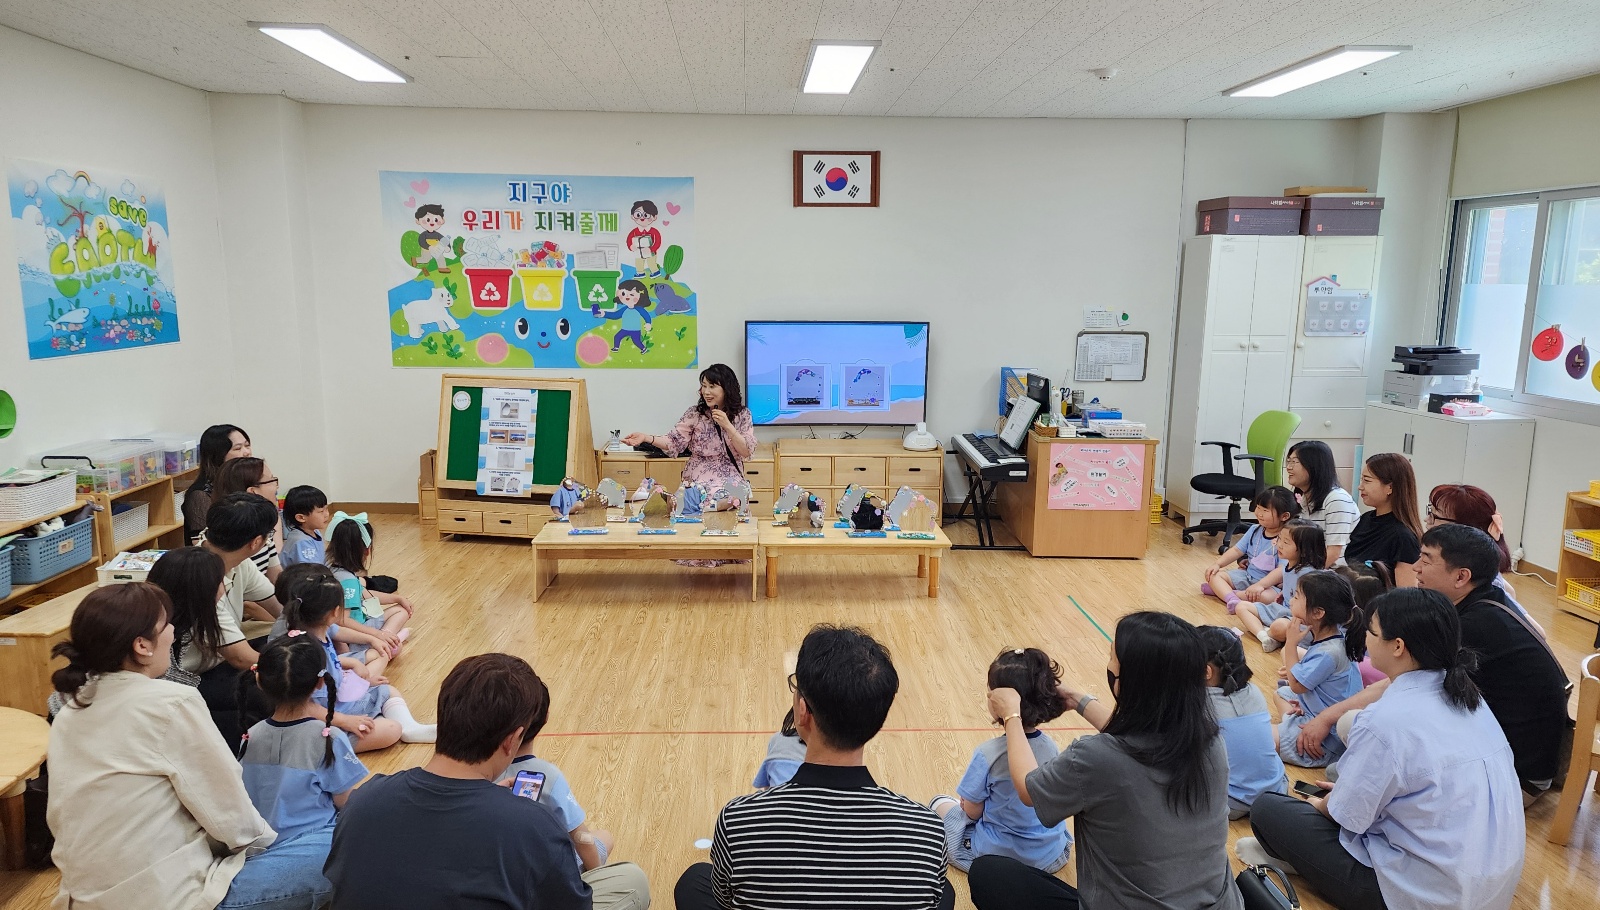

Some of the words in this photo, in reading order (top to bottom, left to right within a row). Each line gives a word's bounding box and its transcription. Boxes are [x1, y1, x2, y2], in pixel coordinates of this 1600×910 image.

[508, 181, 572, 205] 지구야
[108, 196, 148, 228] save
[462, 209, 524, 231] 우리가
[534, 211, 619, 235] 지켜줄께
